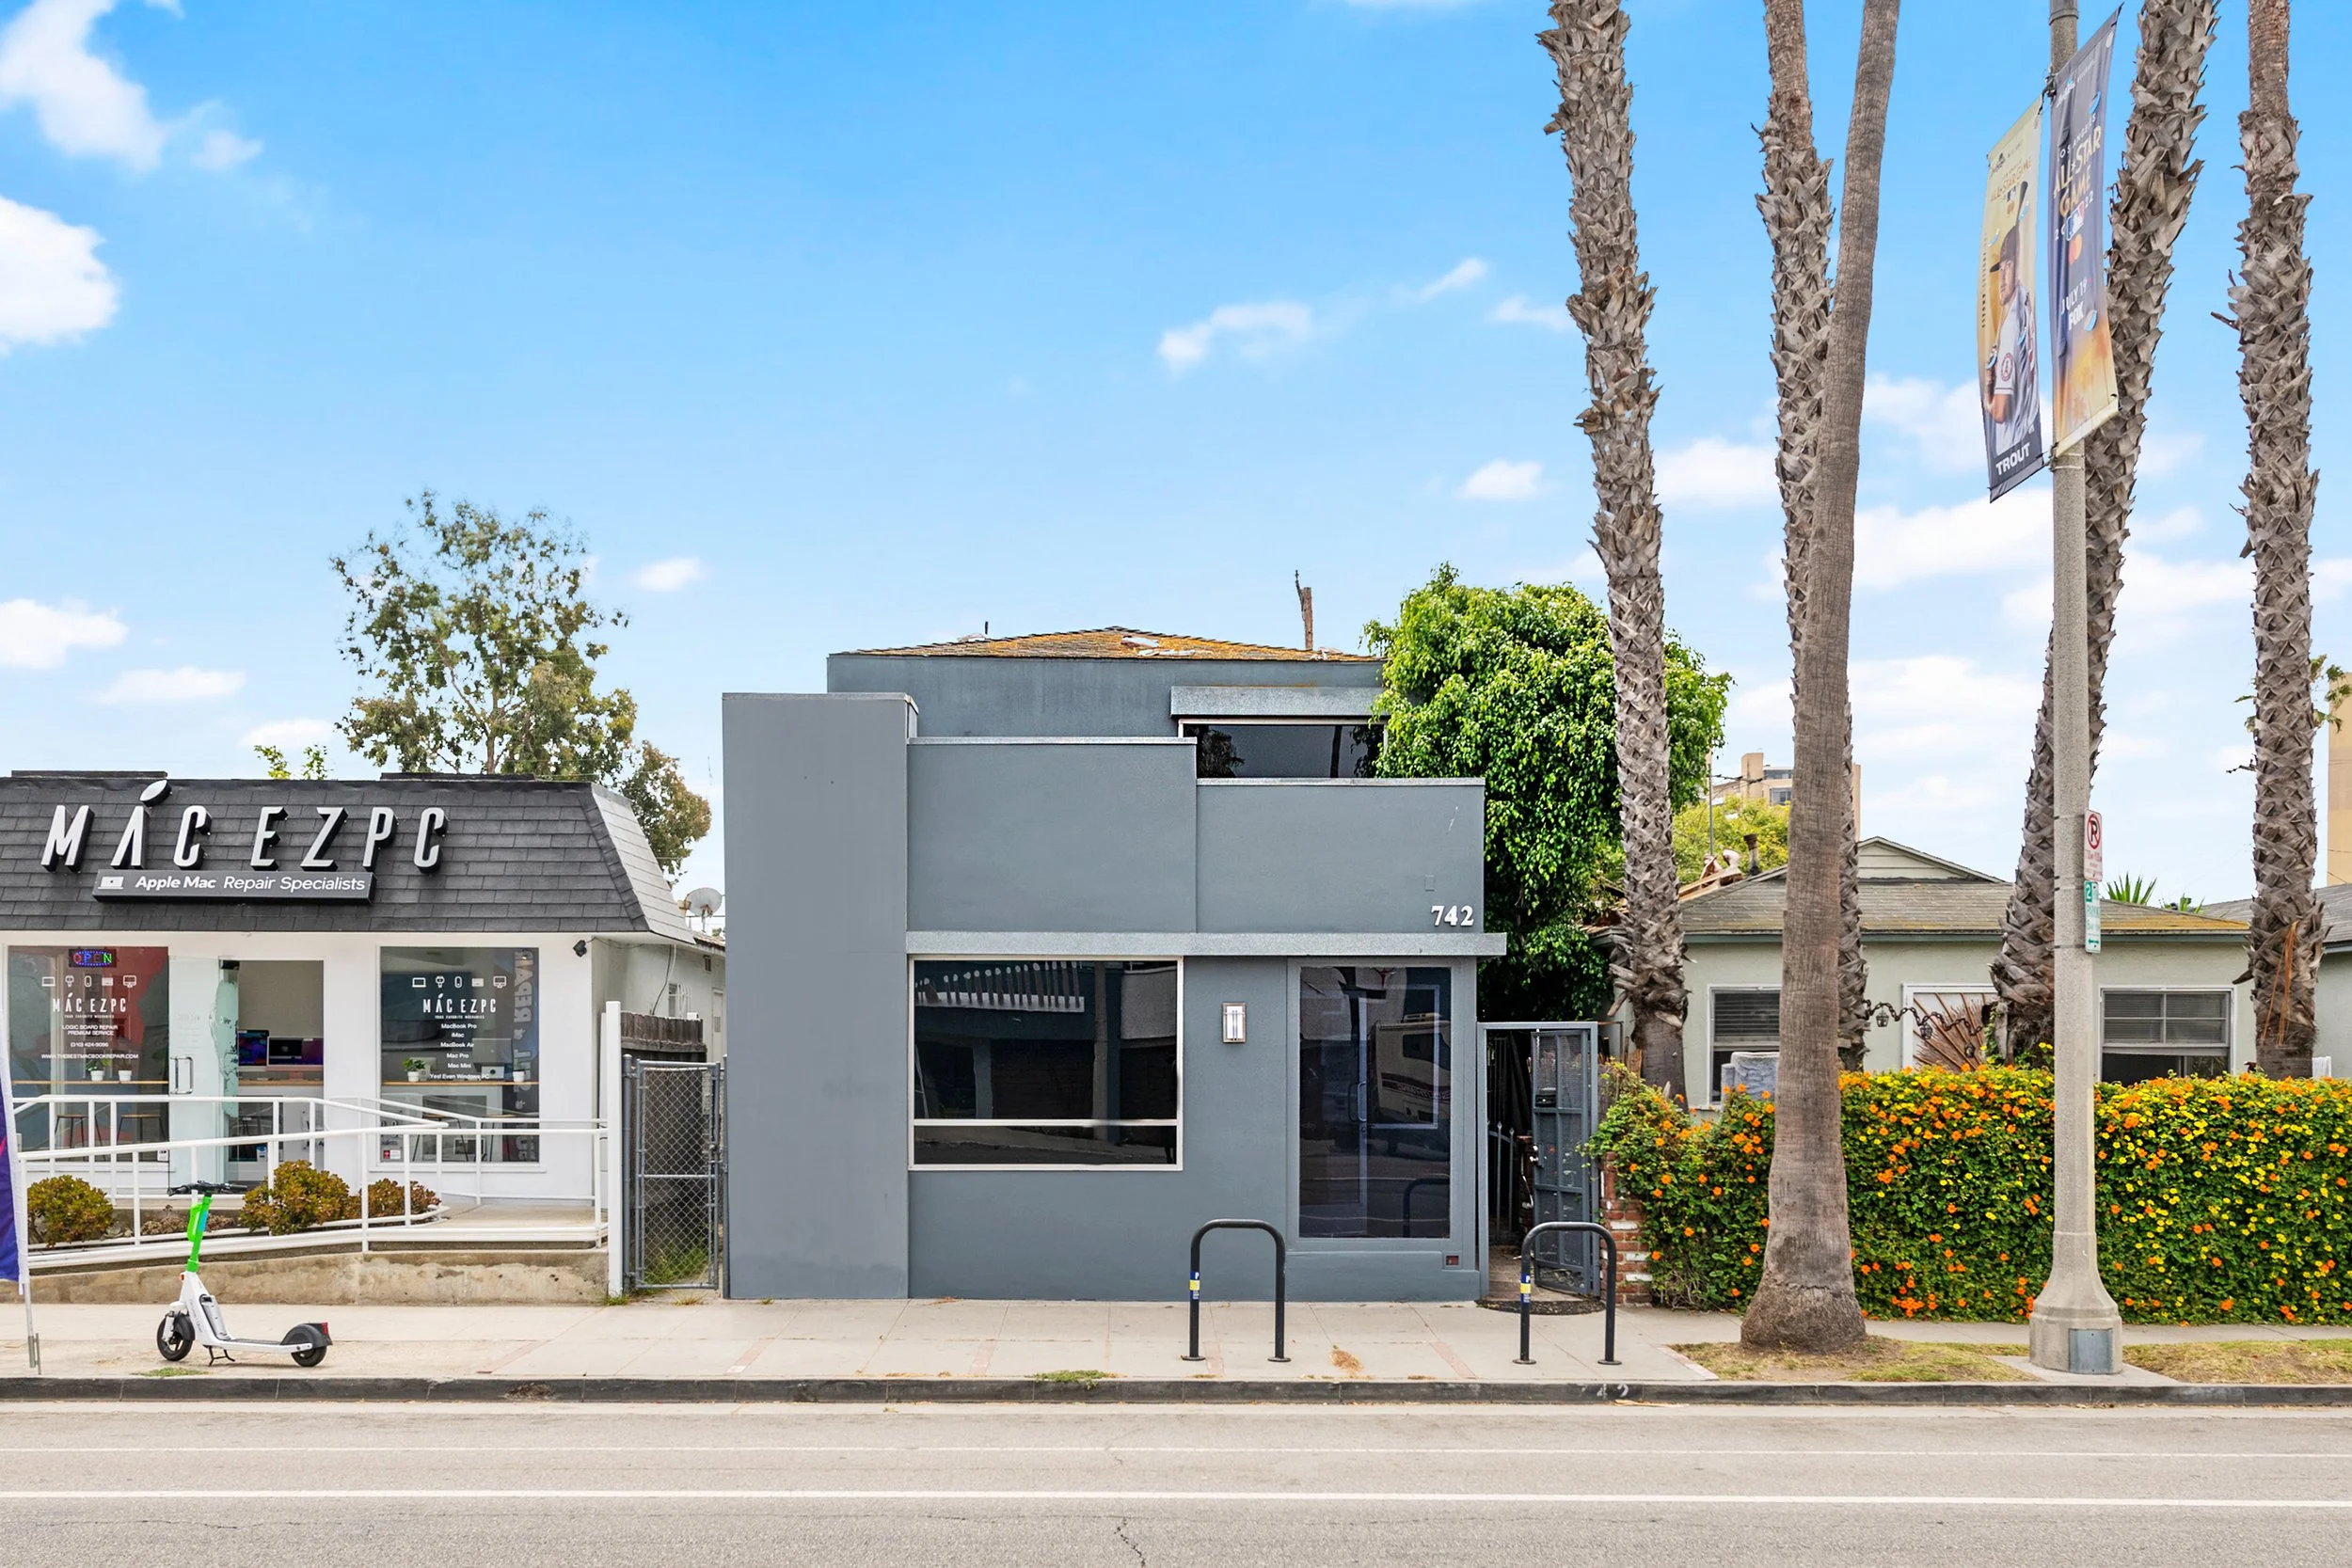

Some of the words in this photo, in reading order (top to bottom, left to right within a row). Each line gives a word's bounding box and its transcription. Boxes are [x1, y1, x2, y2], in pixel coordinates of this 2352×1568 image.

[2060, 164, 2090, 217] GAME
[2060, 285, 2078, 315] JULY
[2068, 301, 2084, 330] FOX
[1995, 442, 2030, 475] TROUT
[135, 876, 181, 891] Apple
[183, 876, 216, 889] Mac
[224, 876, 276, 891] Repair
[279, 876, 366, 893] Specialists
[1431, 905, 1474, 927] 742
[72, 952, 112, 964] OPEN
